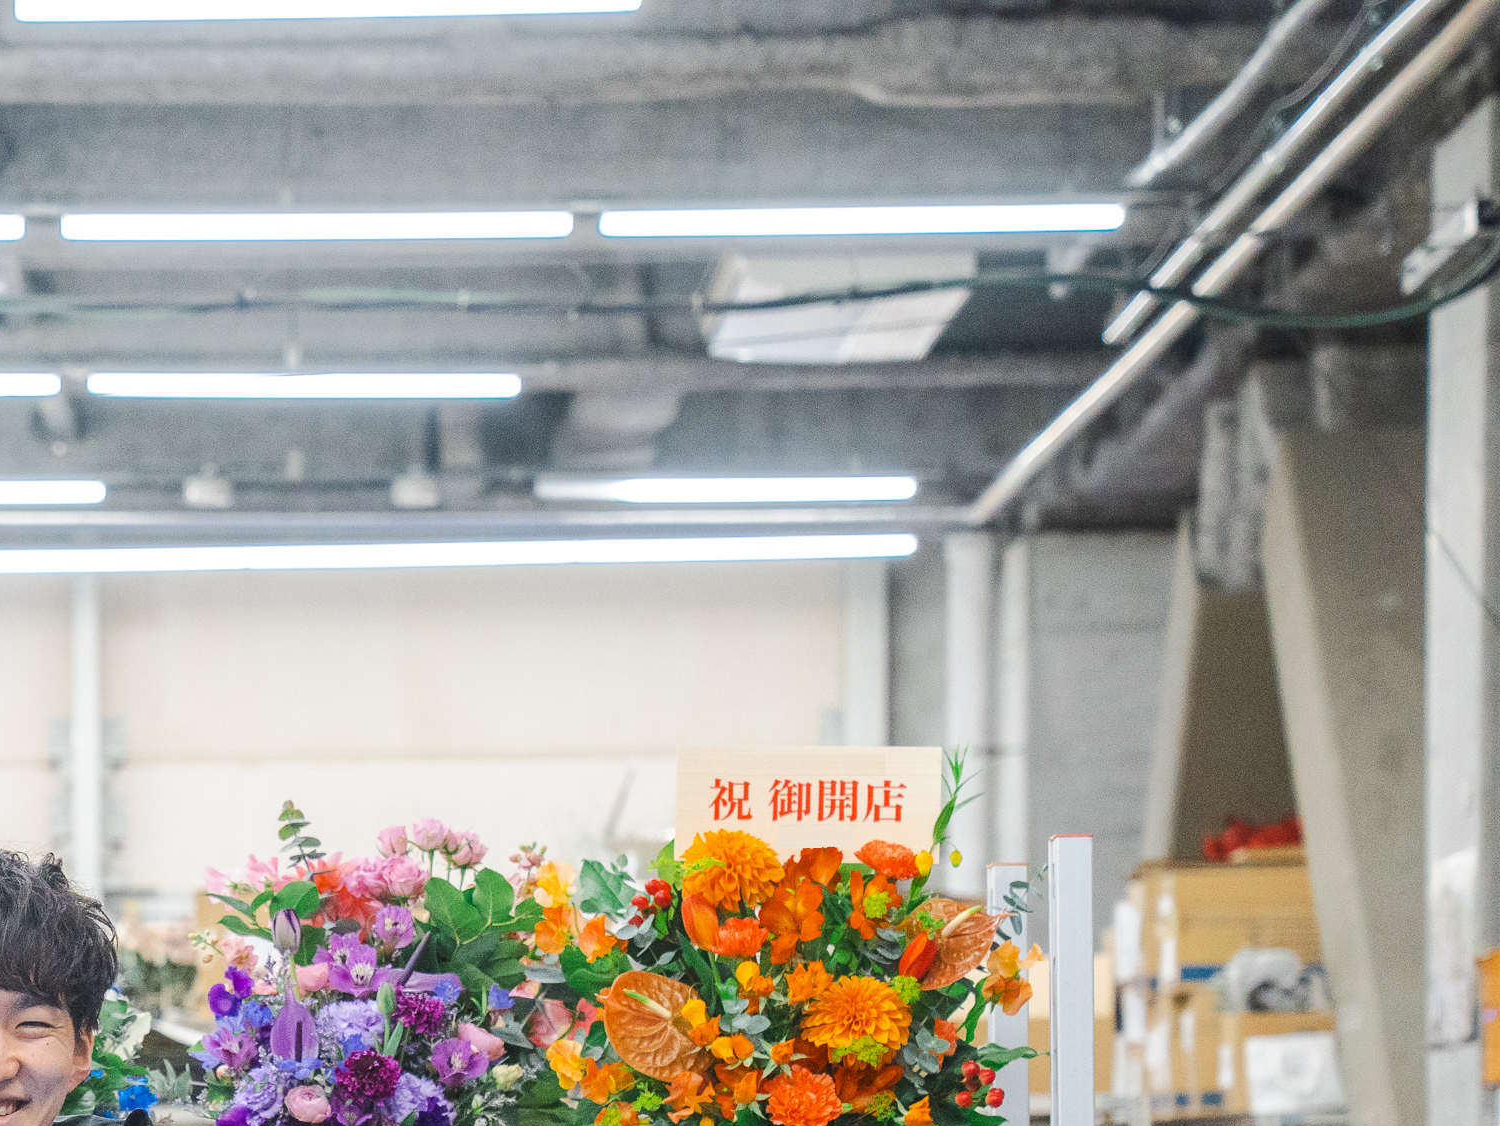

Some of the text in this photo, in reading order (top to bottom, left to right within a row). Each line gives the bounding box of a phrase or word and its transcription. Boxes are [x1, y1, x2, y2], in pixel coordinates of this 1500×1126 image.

[709, 777, 907, 823] 祝 御開店
